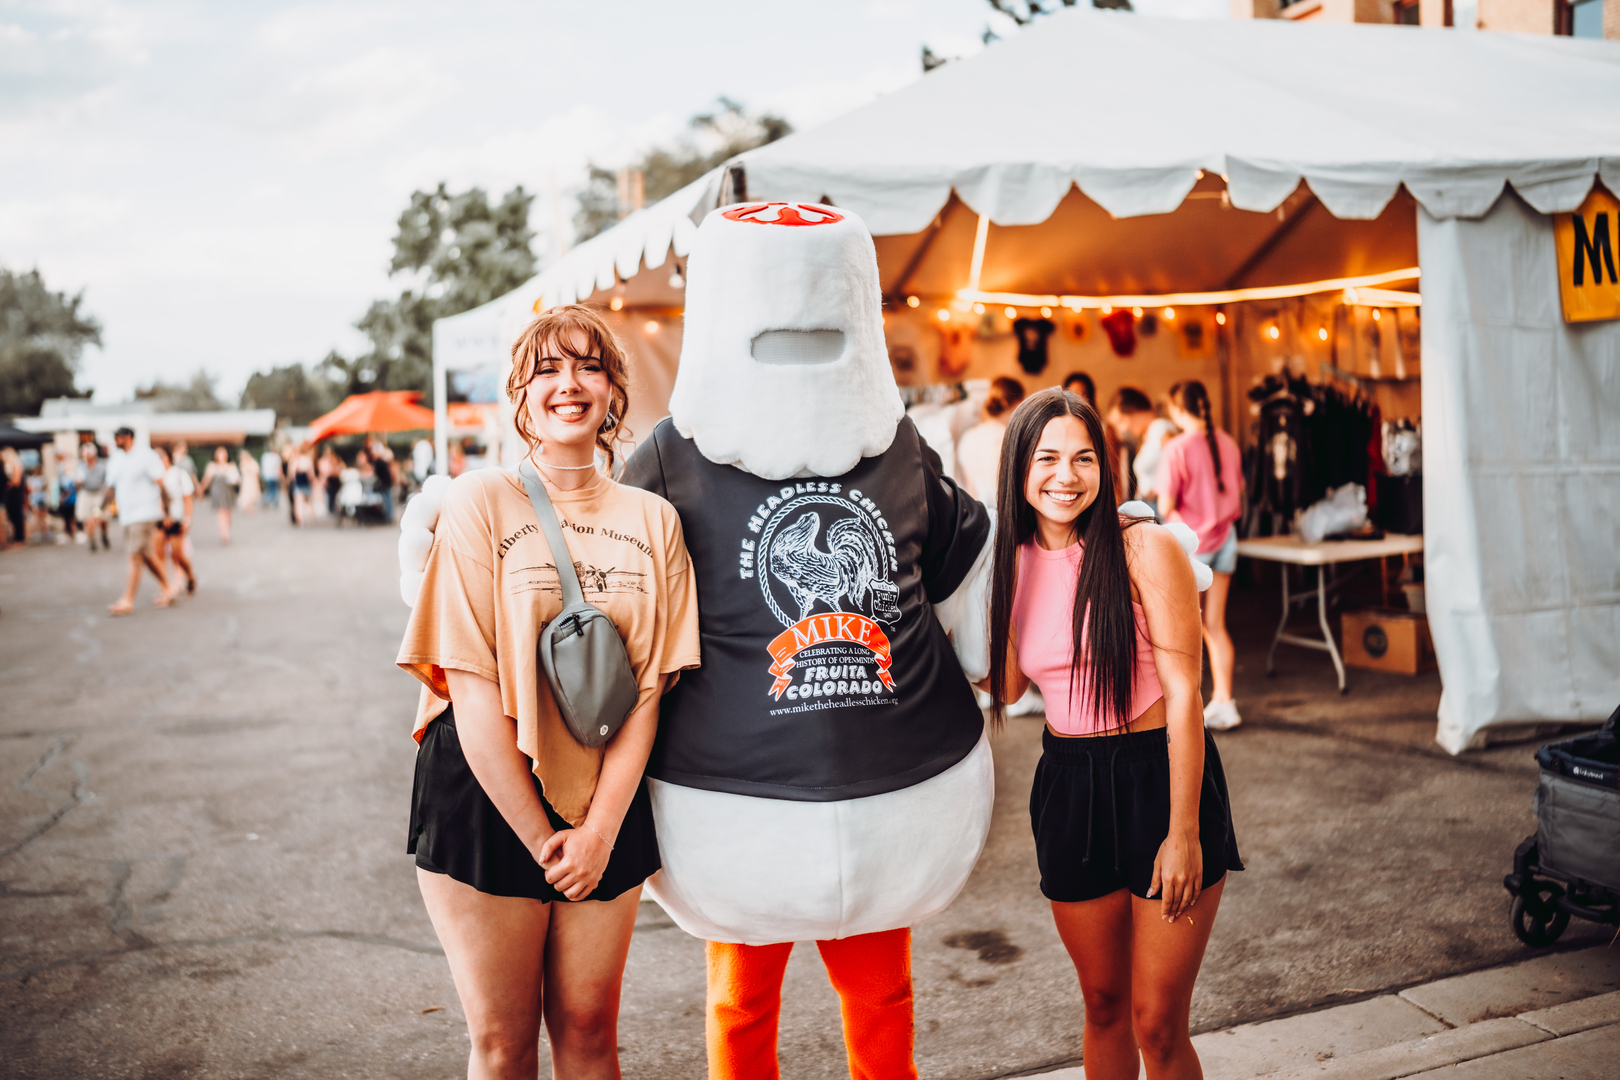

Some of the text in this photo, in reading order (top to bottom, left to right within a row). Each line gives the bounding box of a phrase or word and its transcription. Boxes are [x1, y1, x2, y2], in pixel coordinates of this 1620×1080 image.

[1572, 212, 1620, 287] M
[497, 523, 539, 560] Liberty
[739, 482, 898, 579] THE HEADLESS CHICKEN
[790, 615, 873, 650] MIKE
[796, 657, 827, 668] HISTORY
[799, 647, 870, 658] CELEBRATING A LONG
[803, 664, 868, 682] FRUITA
[785, 680, 883, 700] COLORADO
